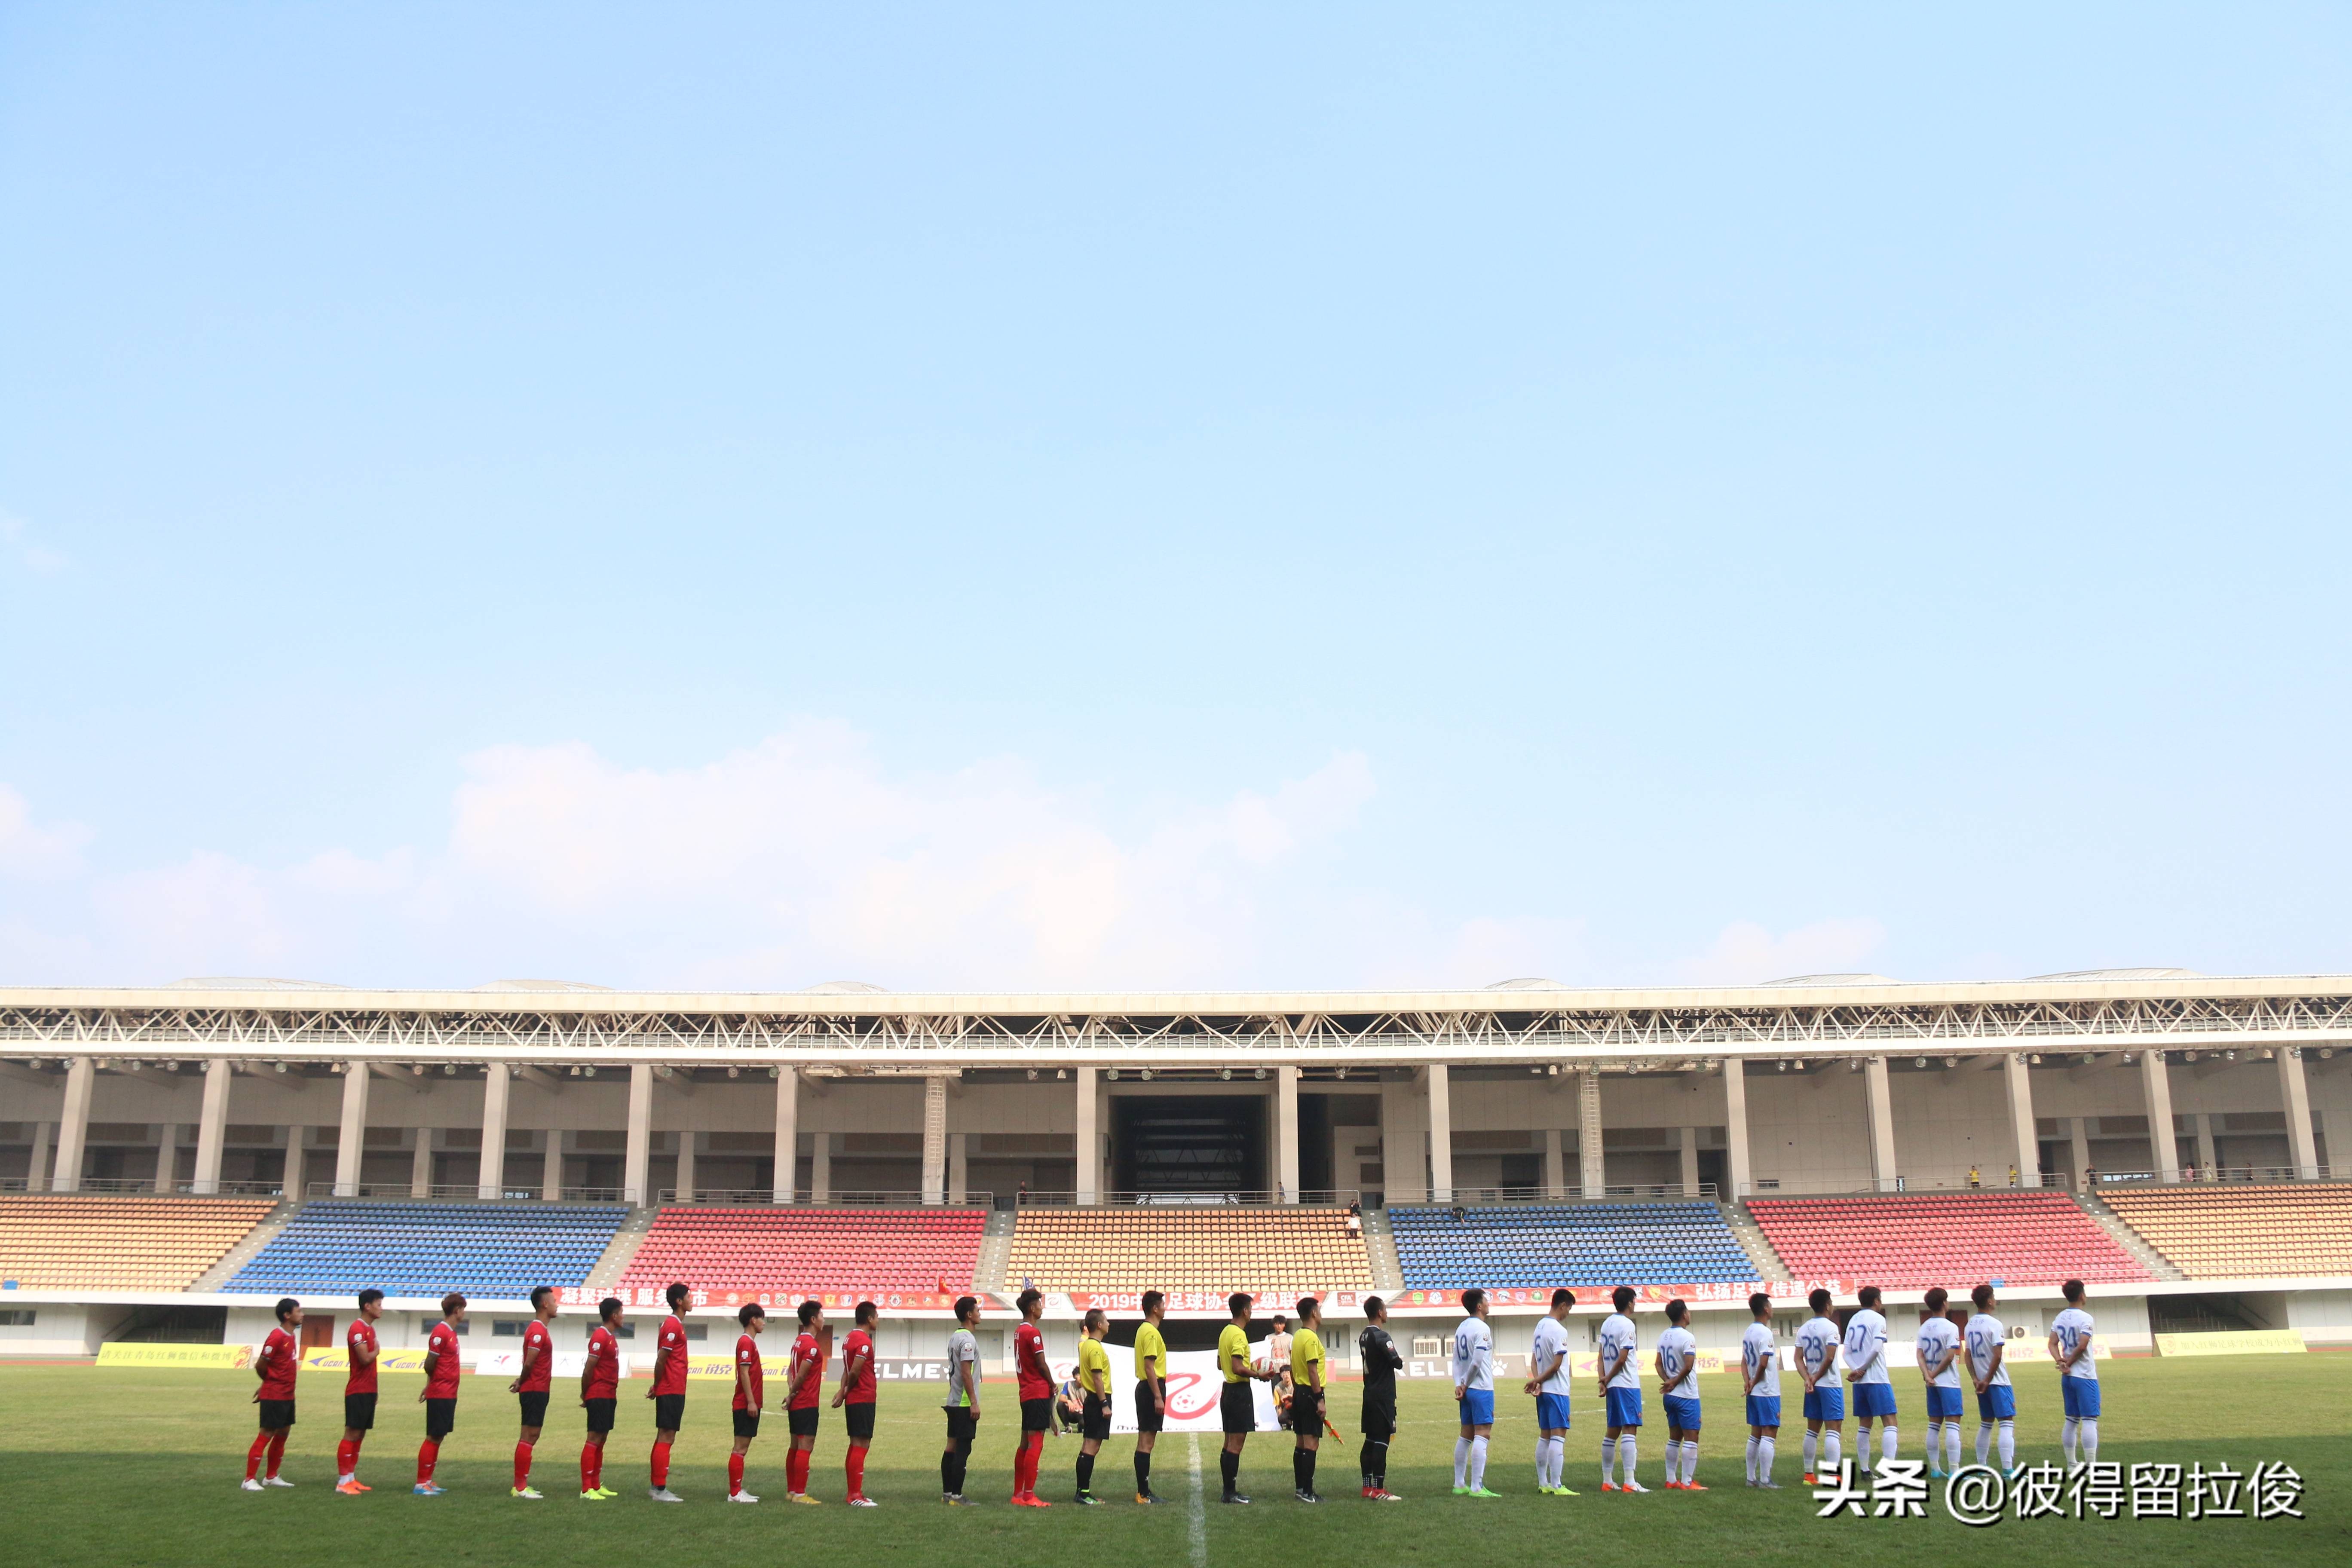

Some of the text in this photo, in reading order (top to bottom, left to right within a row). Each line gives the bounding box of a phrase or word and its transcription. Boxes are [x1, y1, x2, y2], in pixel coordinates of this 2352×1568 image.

[560, 1287, 708, 1306] 凝聚球迷 服务市
[1088, 1291, 1315, 1310] 2019中足球协级联
[1695, 1282, 1766, 1301] 弘扬足球
[1455, 1334, 1469, 1361] 19
[1601, 1333, 1619, 1361] 26
[1849, 1324, 1866, 1352] 27
[1922, 1337, 1942, 1364] 22
[1968, 1331, 1986, 1358] 12
[1660, 1344, 1676, 1372] 16
